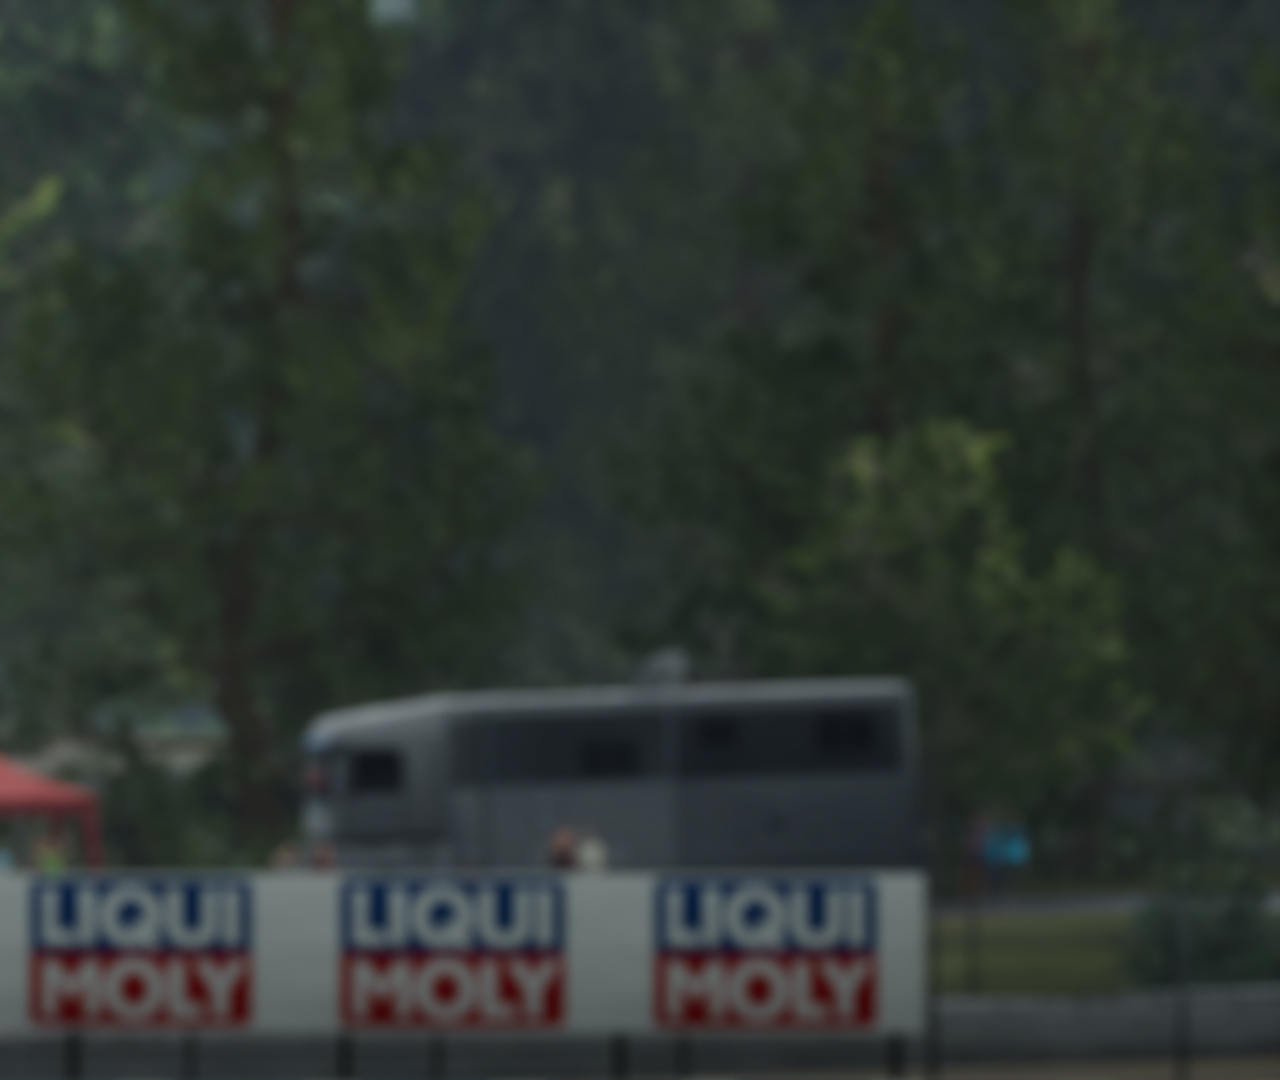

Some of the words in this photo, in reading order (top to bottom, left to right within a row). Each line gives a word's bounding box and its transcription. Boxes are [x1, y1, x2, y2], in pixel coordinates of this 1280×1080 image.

[41, 883, 248, 947] LIQUI
[350, 884, 556, 948] LIQUI
[666, 882, 868, 948] LIQUI
[40, 958, 248, 1016] MOLY
[350, 958, 558, 1018] MOLY
[666, 961, 870, 1020] MOLY
